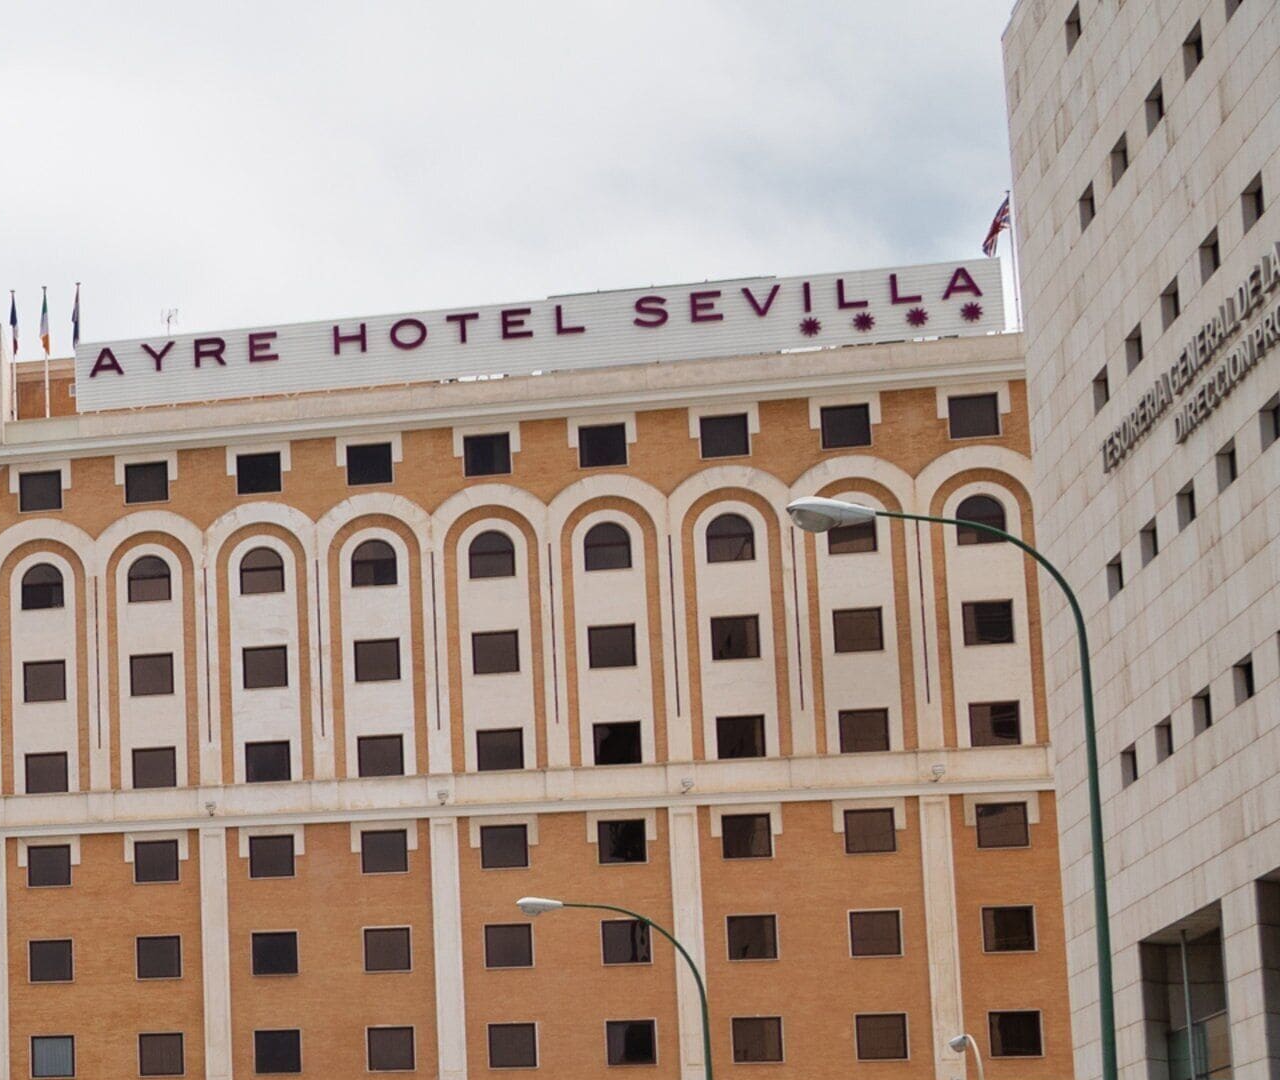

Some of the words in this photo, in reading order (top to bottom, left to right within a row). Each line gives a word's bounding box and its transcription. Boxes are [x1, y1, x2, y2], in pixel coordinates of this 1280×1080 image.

[89, 331, 279, 378] AYRE
[332, 304, 586, 355] HOTEL
[633, 267, 983, 328] SEVILLA
[1101, 372, 1173, 473] TESORERIA
[1168, 297, 1239, 395] GENERAL
[1174, 334, 1255, 444] DIRECCION
